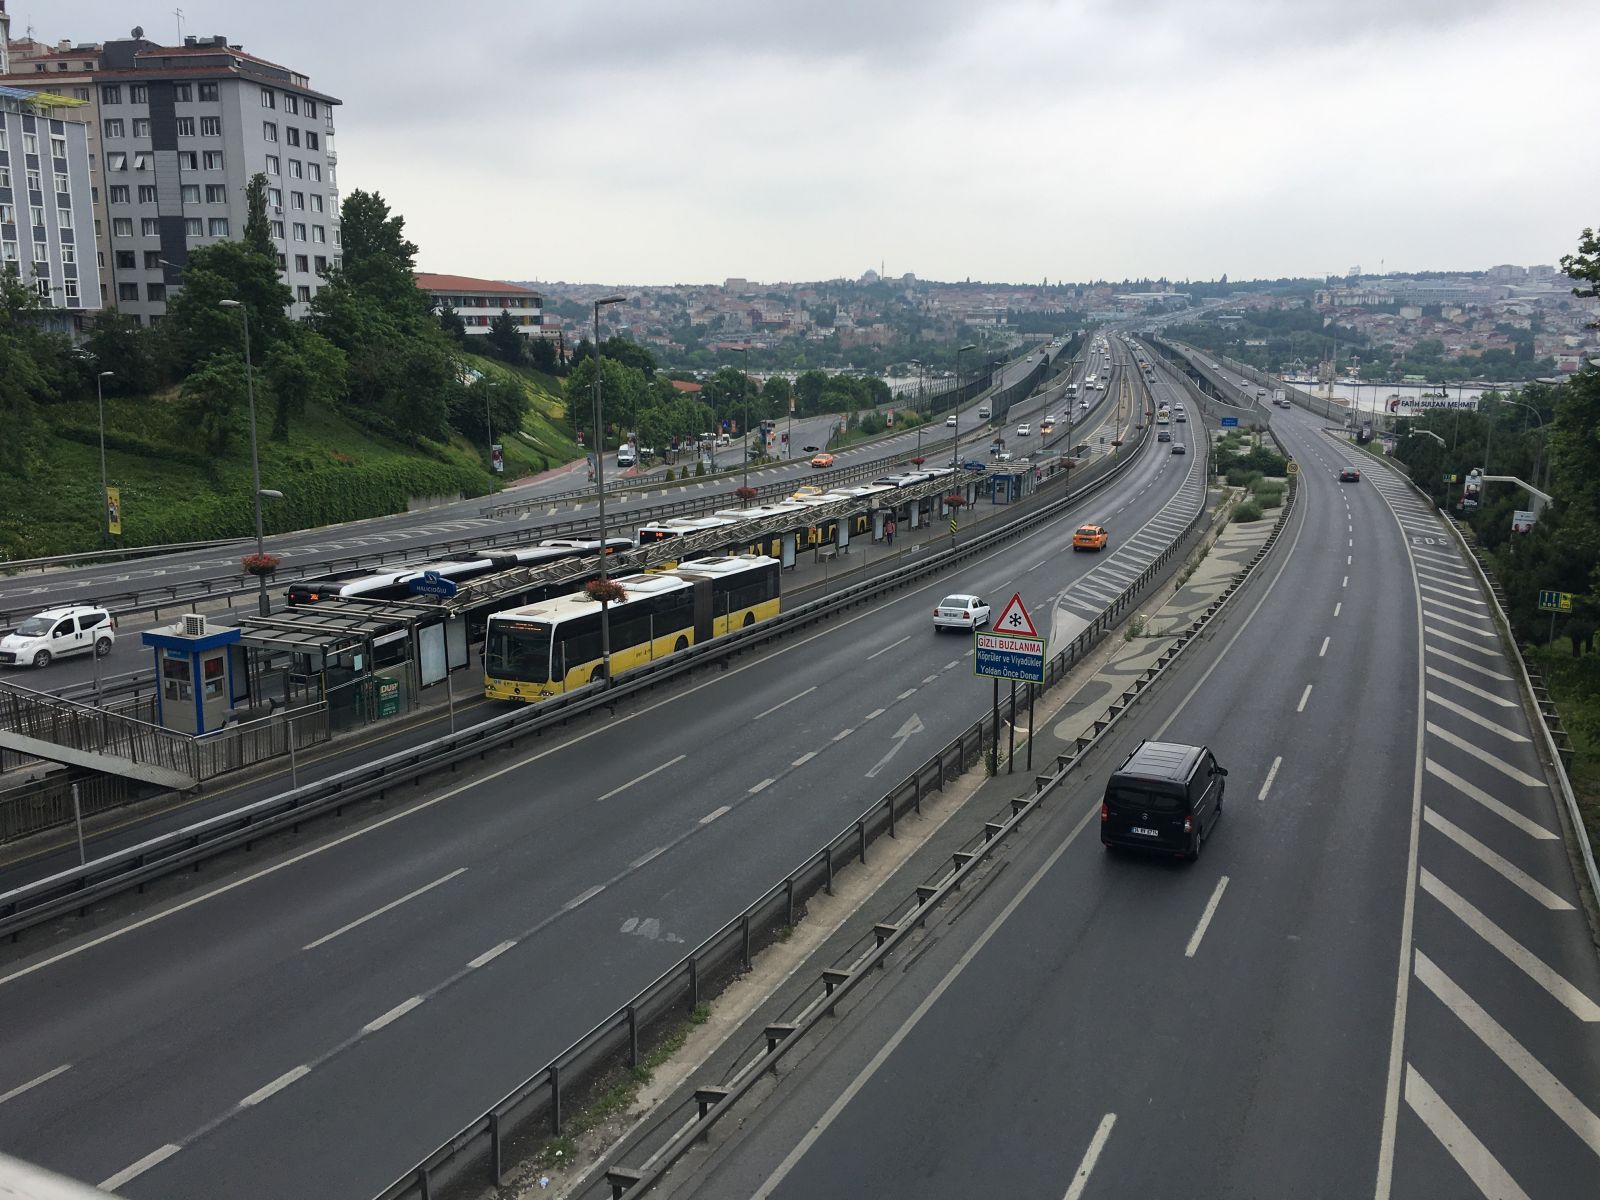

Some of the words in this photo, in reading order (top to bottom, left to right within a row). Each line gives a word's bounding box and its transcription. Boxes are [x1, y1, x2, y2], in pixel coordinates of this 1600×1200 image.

[1420, 400, 1446, 408] SULTAN
[1447, 401, 1476, 409] MEHMET
[1411, 536, 1448, 546] EDS
[978, 637, 998, 649] GİZLİ
[998, 640, 1042, 653] BUZLANMA
[977, 651, 1002, 663] Köprüler
[1002, 655, 1011, 663] ve
[1011, 655, 1042, 668] Viyadükler
[980, 664, 1002, 676] Yoldan
[1002, 666, 1019, 678] Önce
[1019, 670, 1040, 680] Donar
